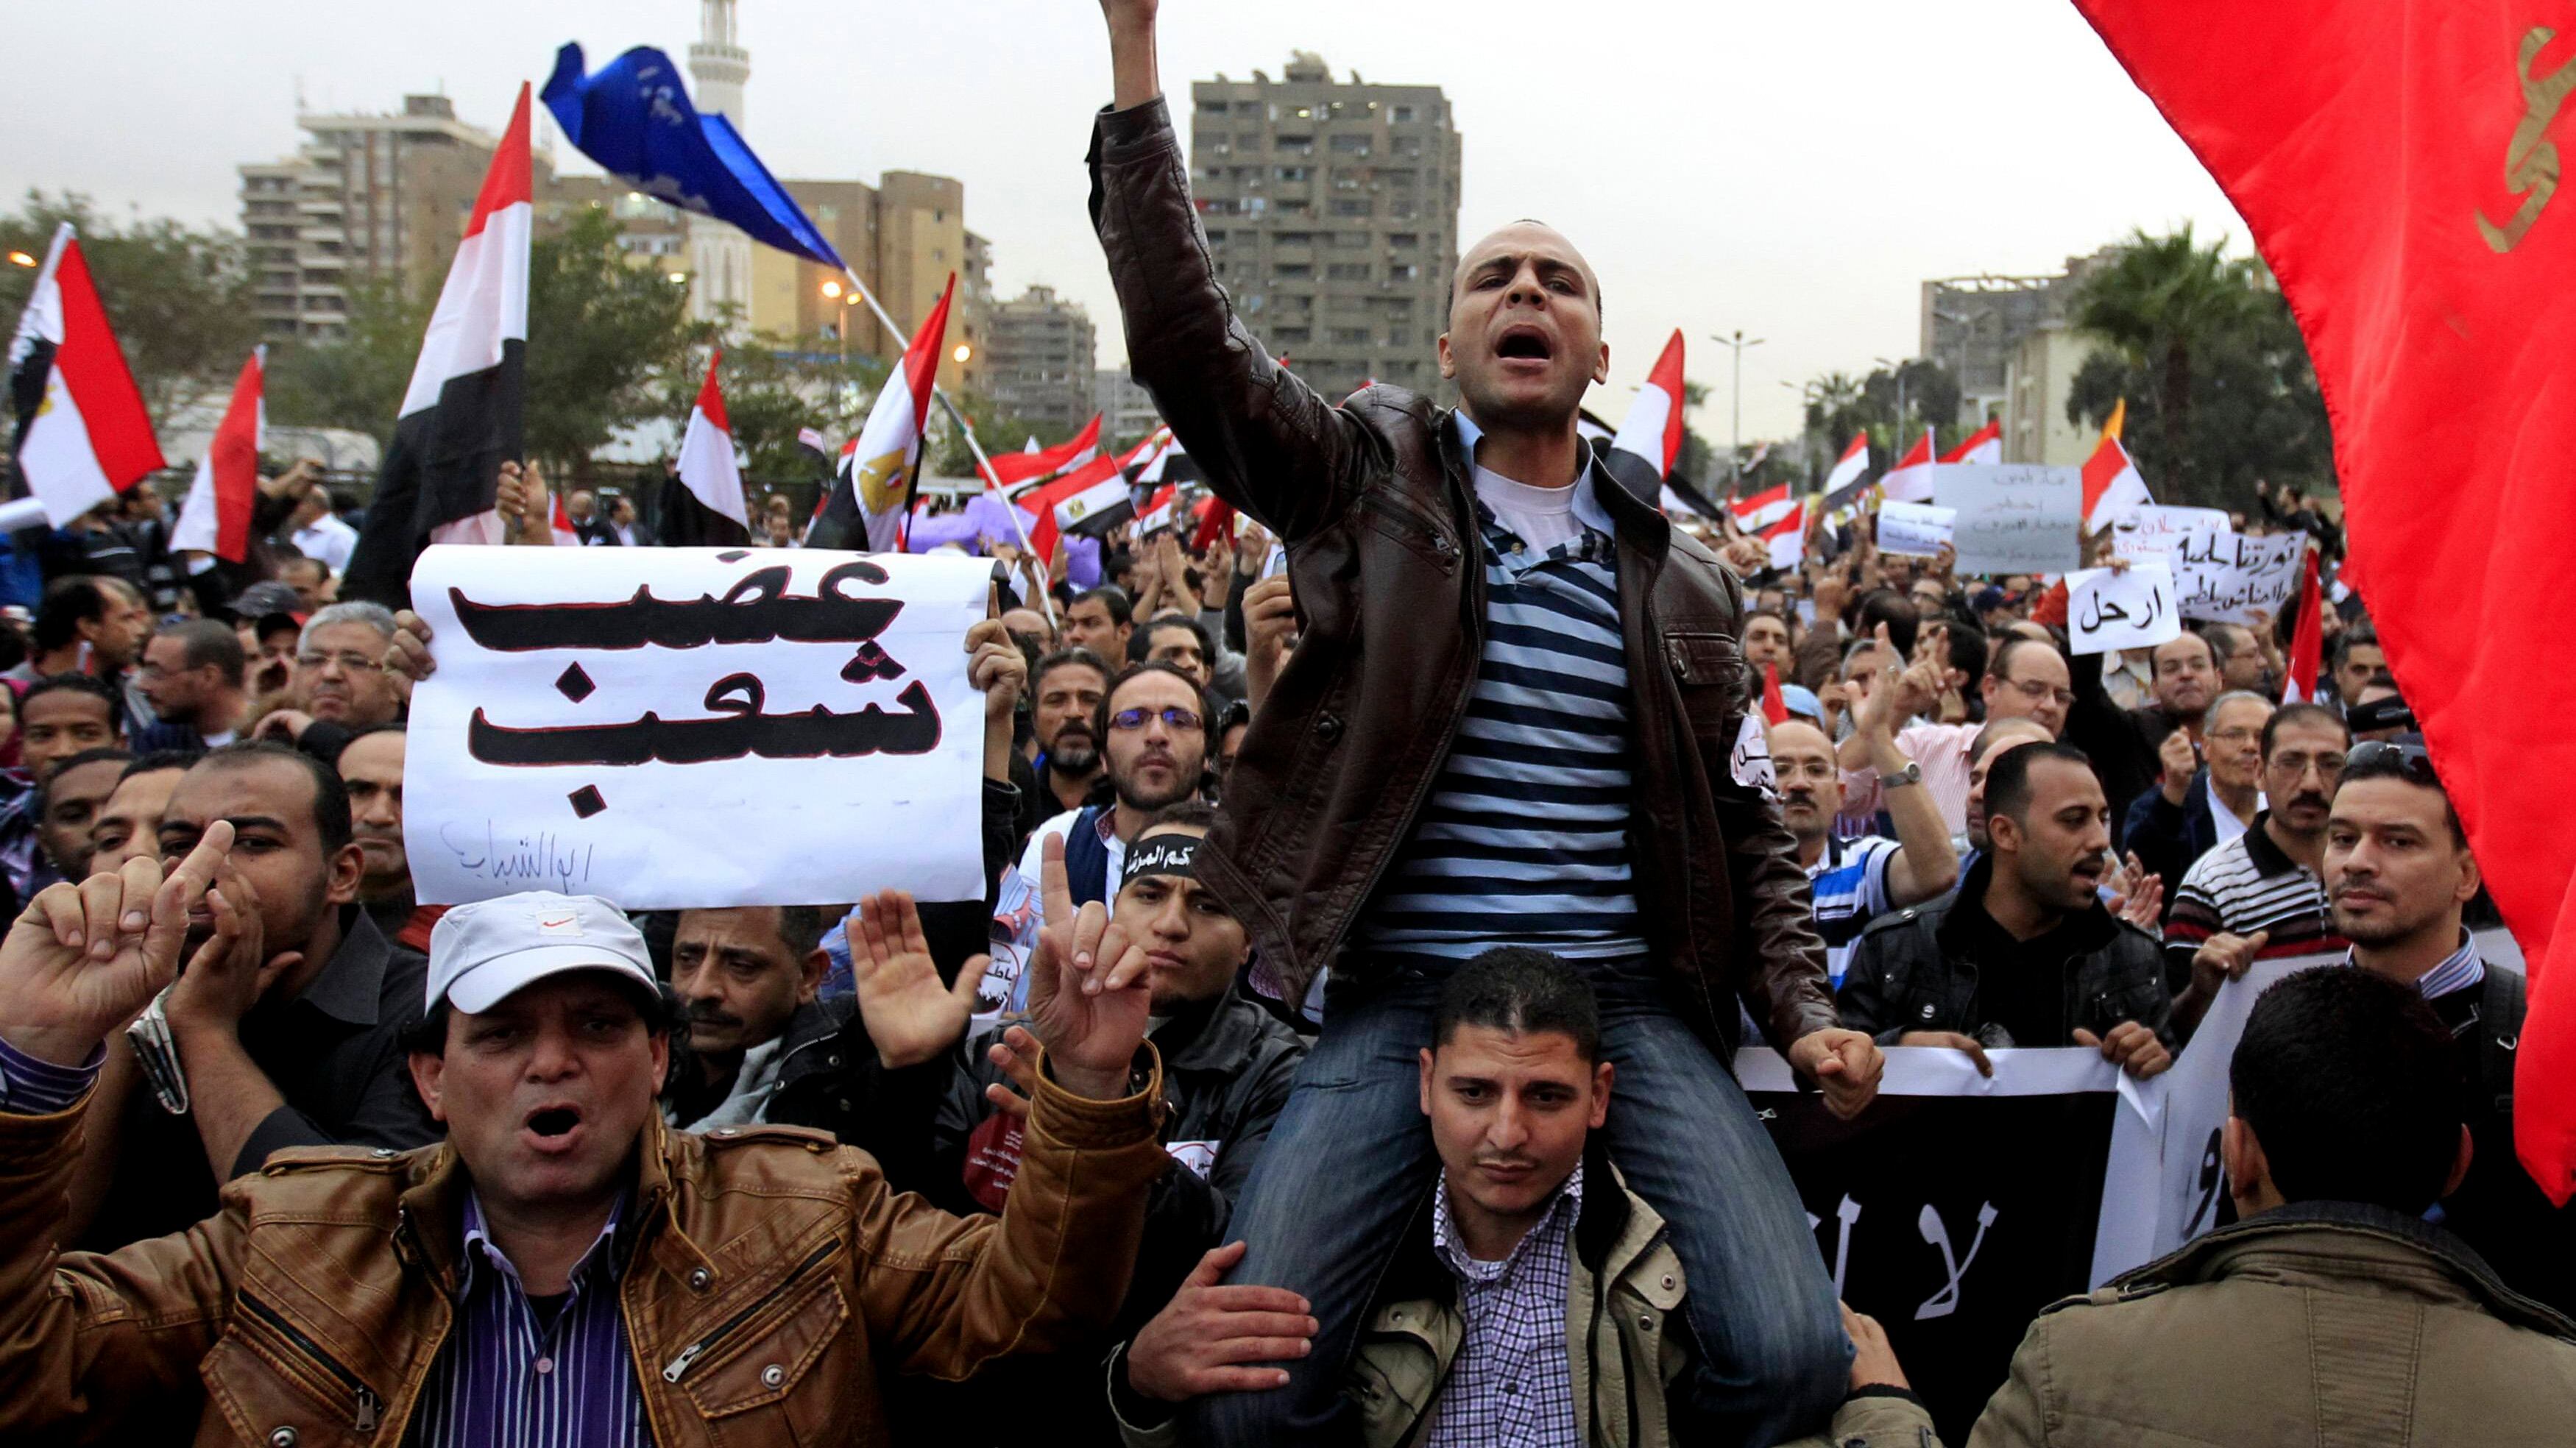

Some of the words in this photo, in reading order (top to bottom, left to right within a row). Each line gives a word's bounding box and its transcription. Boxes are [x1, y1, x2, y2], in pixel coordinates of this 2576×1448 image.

[2176, 526, 2232, 572] سلمية
[448, 550, 905, 703] غضب
[2080, 584, 2162, 634] ارحل
[468, 639, 943, 820] شعب
[1163, 845, 1195, 870] كم
[984, 965, 1013, 987] باط
[1914, 1199, 1999, 1321] لا
